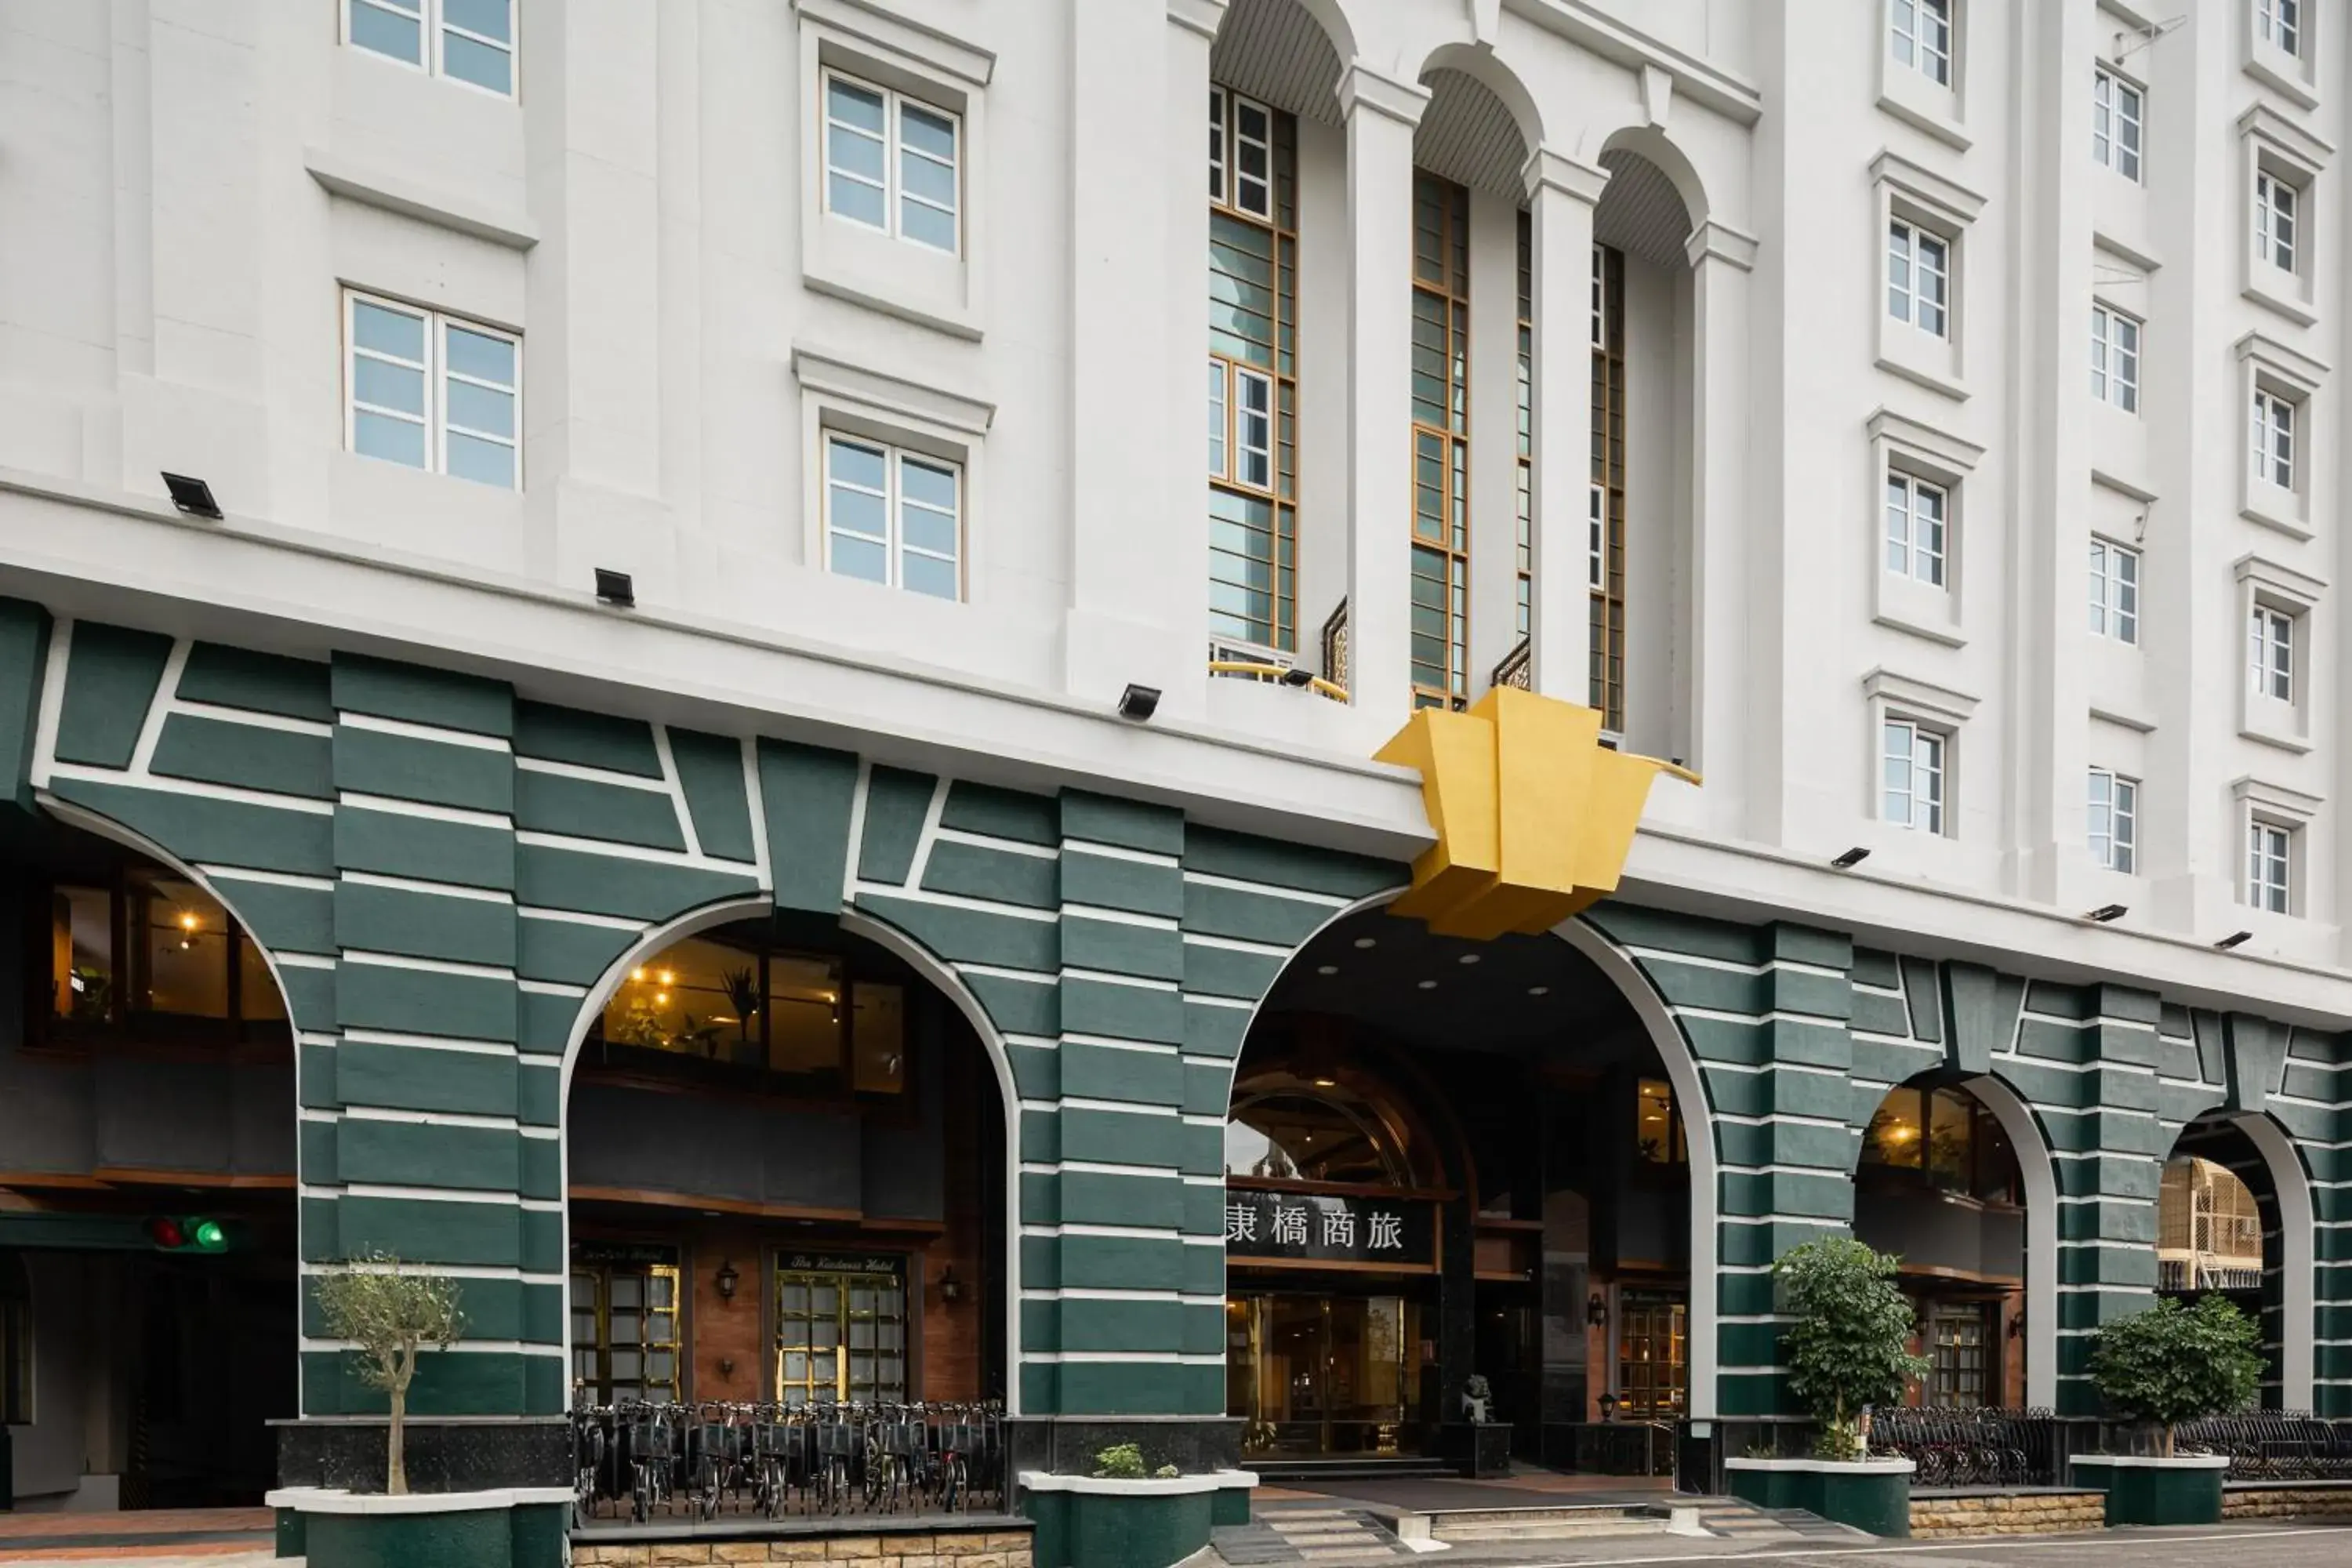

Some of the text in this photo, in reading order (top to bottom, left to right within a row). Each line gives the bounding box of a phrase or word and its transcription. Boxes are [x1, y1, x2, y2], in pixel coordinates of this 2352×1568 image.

[1225, 1202, 1403, 1249] 康橋商旅
[866, 1258, 895, 1272] Hotel
